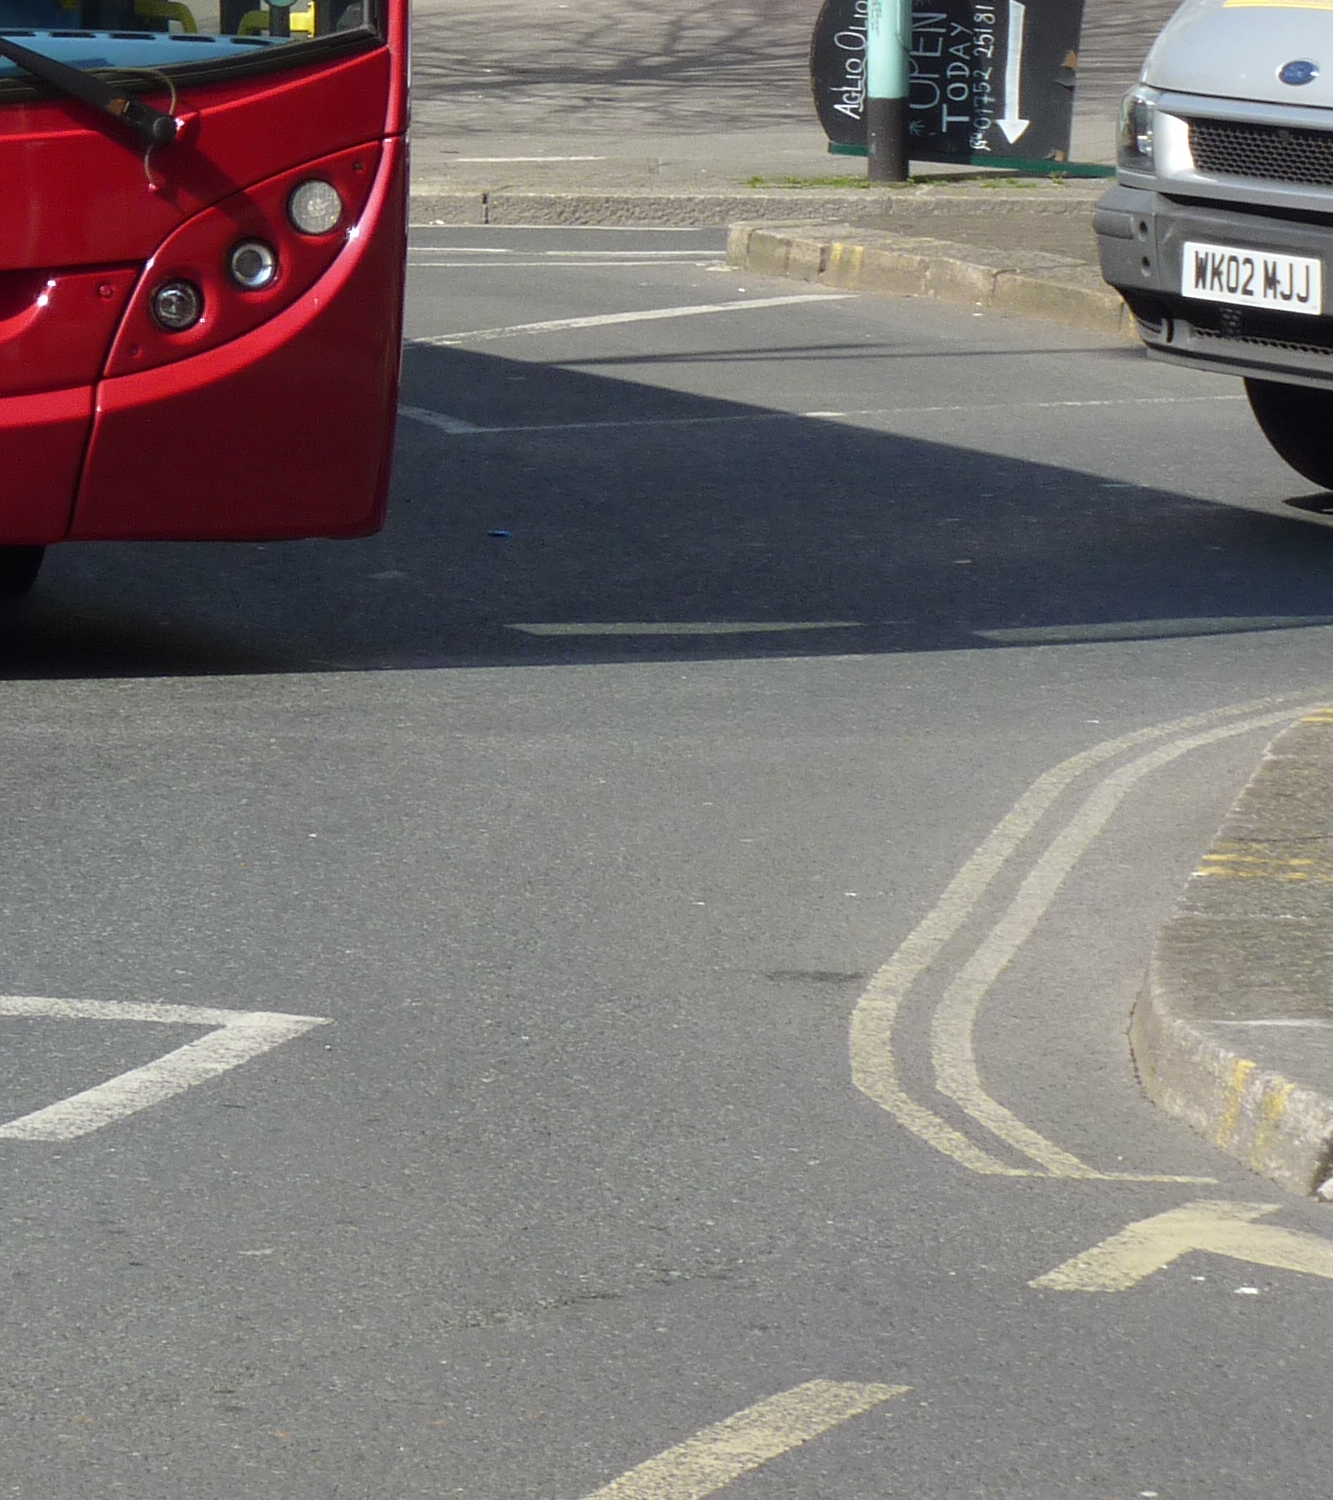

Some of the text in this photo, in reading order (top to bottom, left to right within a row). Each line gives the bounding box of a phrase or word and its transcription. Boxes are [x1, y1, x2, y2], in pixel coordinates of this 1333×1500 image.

[941, 21, 974, 134] TODAY
[972, 66, 997, 131] 01752
[1194, 250, 1310, 304] WK02 MJJ
